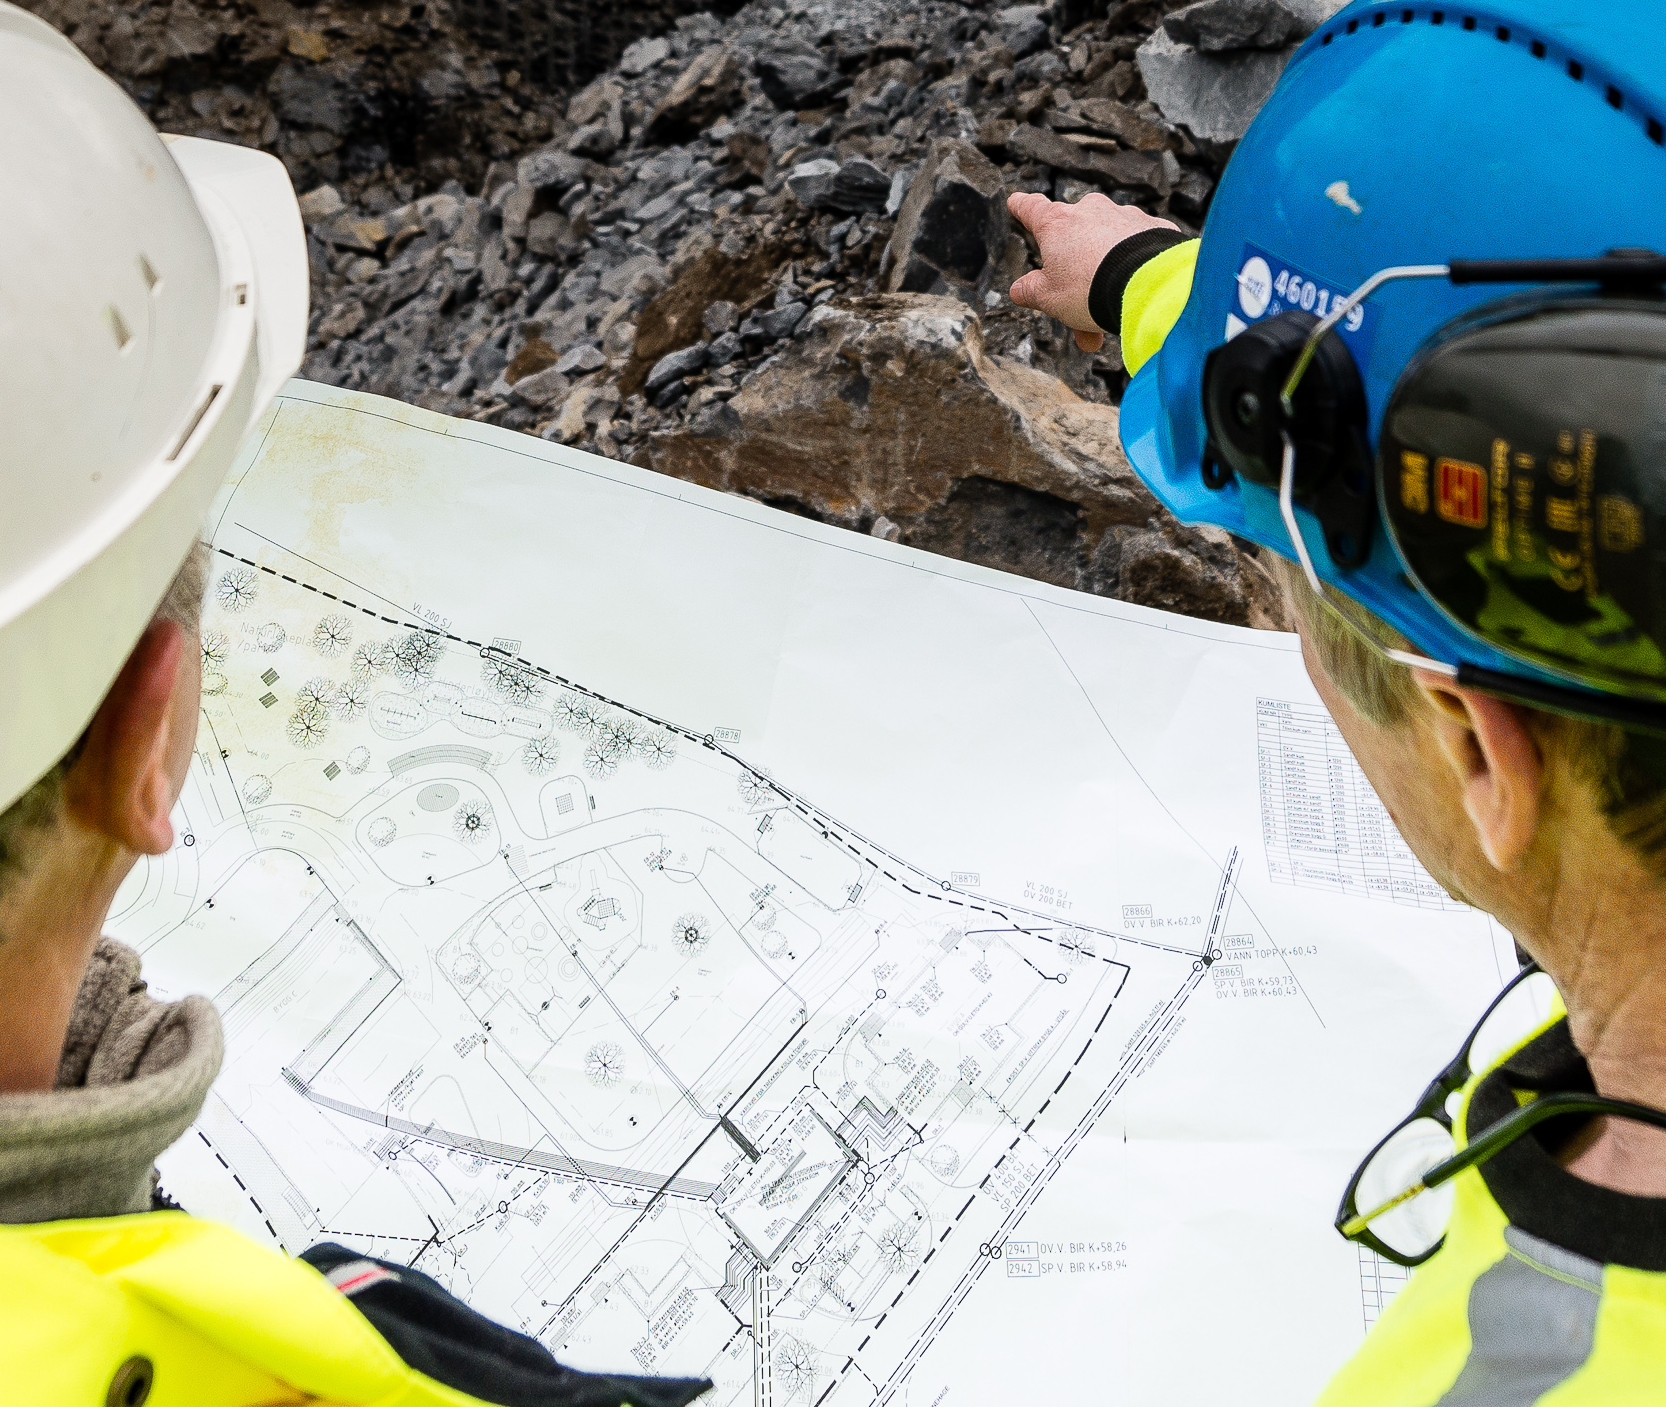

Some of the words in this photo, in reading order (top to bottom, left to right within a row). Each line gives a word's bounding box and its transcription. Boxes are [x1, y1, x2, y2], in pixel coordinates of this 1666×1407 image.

[413, 602, 422, 614] VL
[425, 609, 440, 623] 200
[441, 618, 452, 629] SJ
[1257, 699, 1291, 710] KUMLISTE
[715, 729, 740, 740] 28878
[954, 874, 978, 884] 28879
[1026, 881, 1035, 890] VL
[1040, 885, 1054, 895] 200
[1058, 890, 1068, 899] SJ
[1024, 890, 1036, 899] OV
[1039, 894, 1054, 904] 200
[1056, 899, 1073, 910] BET
[1125, 907, 1150, 916] 28866
[1150, 919, 1164, 927] BIR
[1226, 937, 1253, 947] 28864
[1226, 952, 1252, 961] VANN
[1256, 950, 1278, 959] TOPP
[1215, 968, 1241, 978] 28865
[1241, 979, 1255, 987] BIR
[1244, 989, 1257, 997] BIR
[982, 1180, 994, 1195] OV
[994, 1164, 1008, 1181] 400
[1006, 1148, 1022, 1164] BET
[991, 1188, 1004, 1203] VL
[1002, 1173, 1016, 1188] 150
[1013, 1161, 1025, 1175] SJ
[1000, 1197, 1012, 1213] SP
[1011, 1180, 1025, 1199] 200
[1023, 1163, 1039, 1183] BET
[1008, 1244, 1031, 1255] 2941
[1070, 1243, 1085, 1253] BIR
[1009, 1263, 1033, 1274] 2942
[1070, 1262, 1085, 1272] BIR
